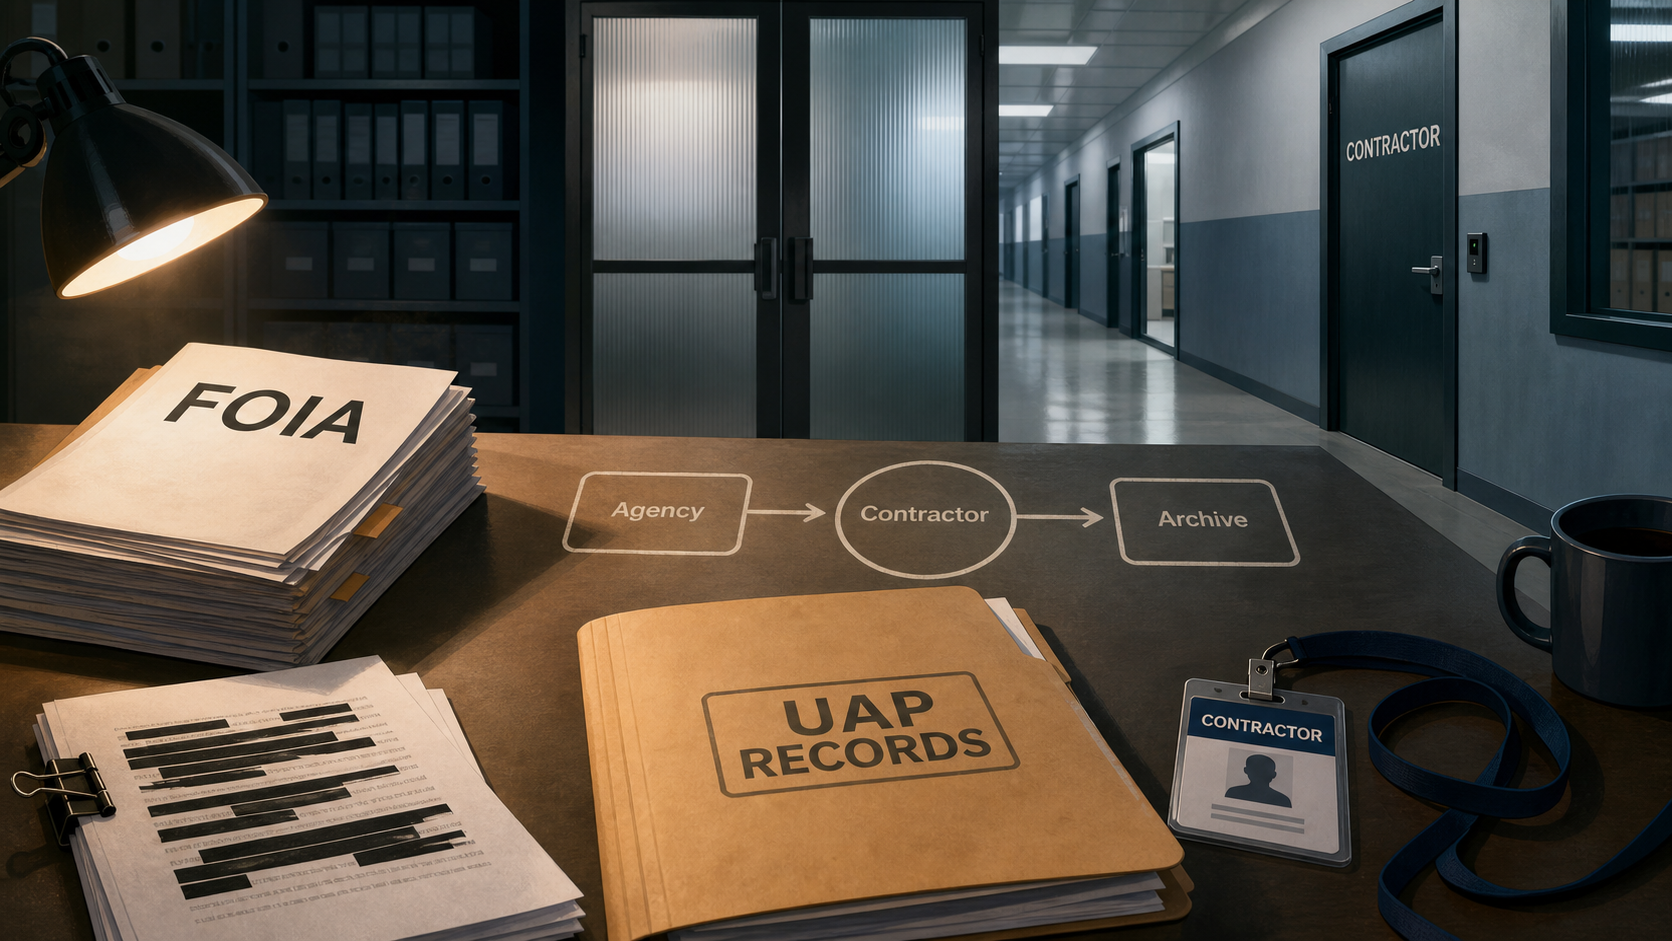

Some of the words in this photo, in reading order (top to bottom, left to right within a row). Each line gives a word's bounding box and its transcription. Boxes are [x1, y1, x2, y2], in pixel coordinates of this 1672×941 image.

[1346, 124, 1441, 162] CONTRACTOR
[163, 382, 364, 444] FOIA
[611, 501, 705, 522] Agency
[860, 504, 989, 523] Contractor
[1158, 510, 1249, 528] Archive
[783, 690, 934, 736] UAP
[1201, 714, 1323, 743] CONTRACTOR
[739, 728, 992, 780] RECORDS
